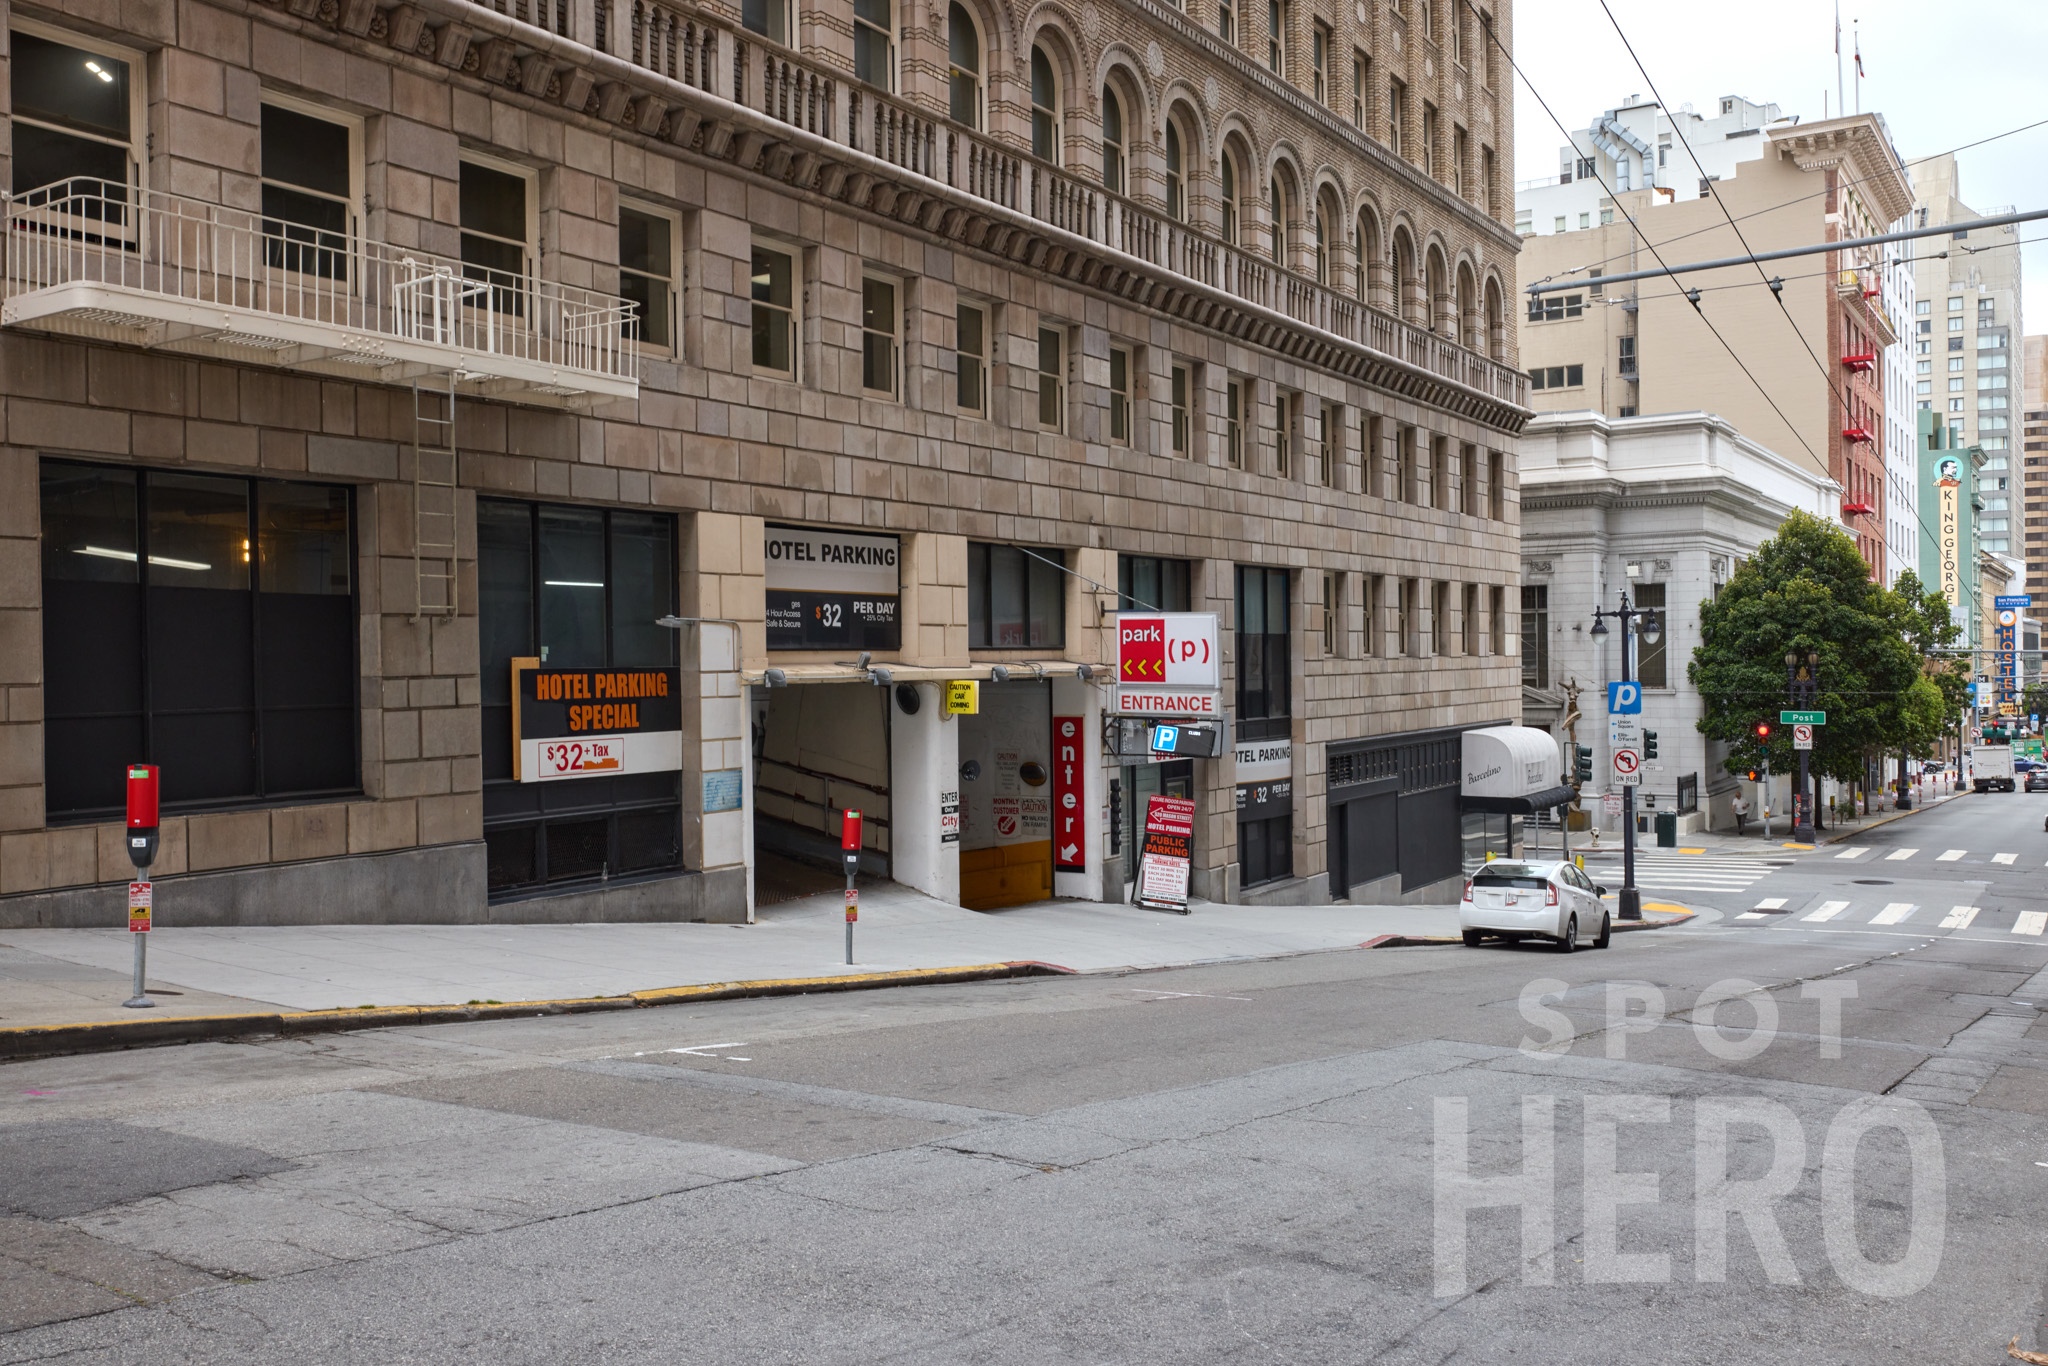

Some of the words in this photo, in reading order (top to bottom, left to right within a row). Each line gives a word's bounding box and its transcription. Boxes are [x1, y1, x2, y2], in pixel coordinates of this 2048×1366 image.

[1944, 490, 1954, 534] KING
[765, 540, 816, 561] OTEL
[822, 544, 896, 566] PARKING
[1944, 538, 1955, 604] GEORGE
[791, 601, 800, 609] ges
[854, 602, 874, 614] PER
[876, 602, 895, 614] DAY
[770, 609, 782, 617] Hour
[783, 610, 800, 618] Access
[766, 619, 778, 628] Safe
[784, 620, 800, 628] Secure
[1122, 625, 1161, 645] park
[2002, 629, 2014, 701] HOSTEL
[536, 672, 591, 700] HOTEL
[596, 672, 668, 699] PARKING
[1122, 695, 1212, 712] ENTRANCE
[569, 702, 640, 732] SPECIAL
[1792, 714, 1814, 722] Post
[1158, 728, 1174, 748] P
[592, 744, 609, 757] Tax
[997, 752, 1018, 760] CAUTION
[1236, 750, 1256, 763] TEL
[1258, 746, 1290, 762] PARKING
[1061, 720, 1076, 833] enter
[1272, 784, 1281, 793] PER
[942, 791, 958, 804] ENTER
[992, 807, 1020, 815] CUSTOMER
[1022, 804, 1047, 812] CAUTION
[942, 816, 958, 828] City
[1147, 823, 1164, 831] HOTEL
[1166, 824, 1190, 834] PARKING
[1150, 834, 1185, 847] PUBLIC
[1146, 844, 1188, 857] PARKING
